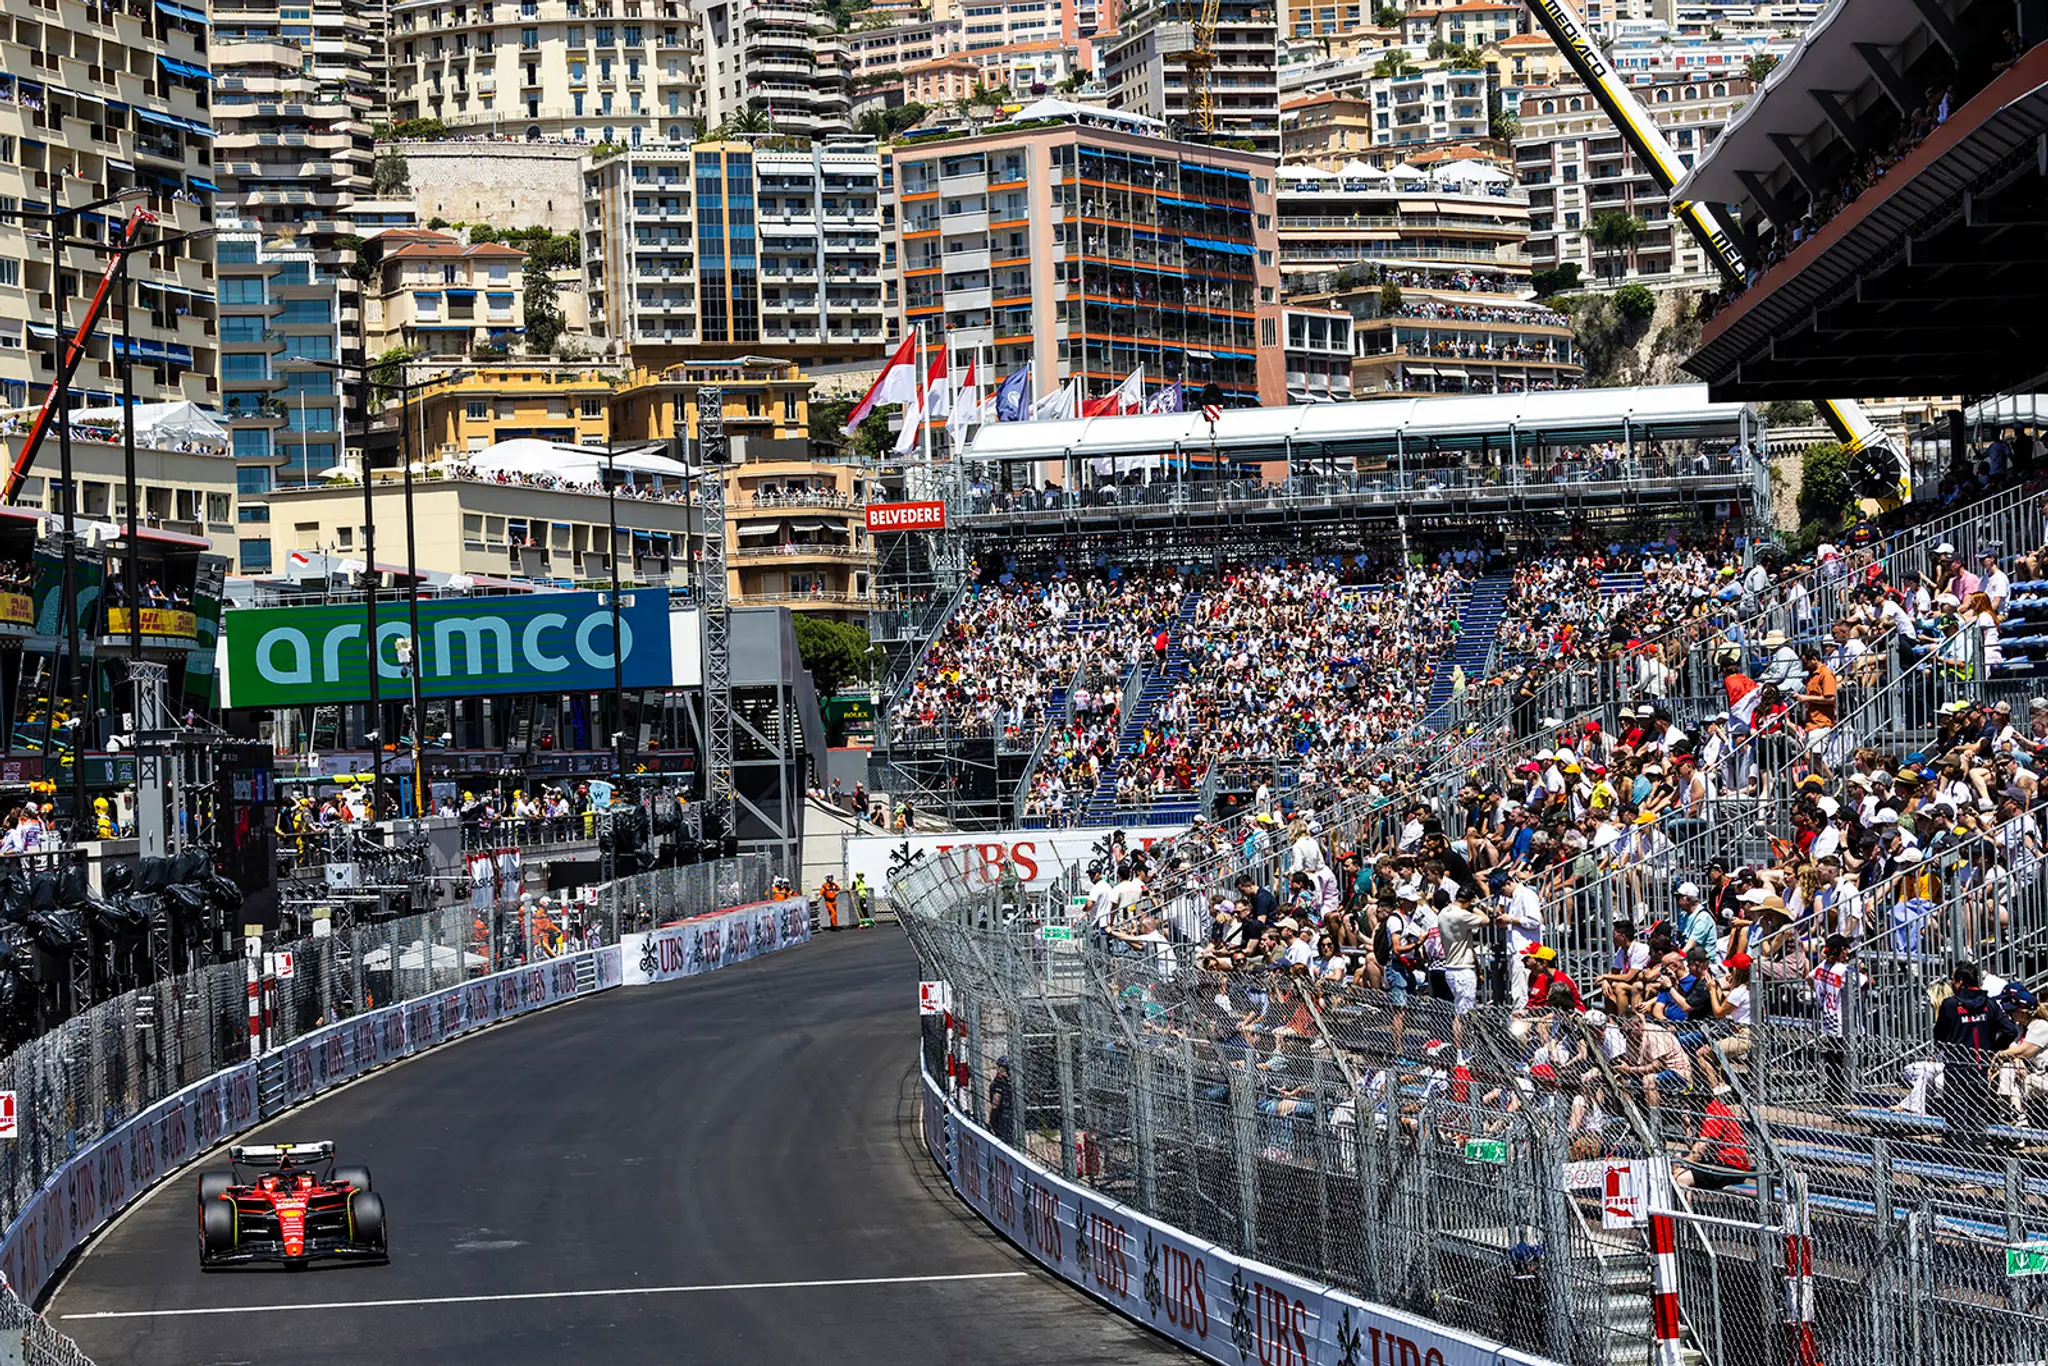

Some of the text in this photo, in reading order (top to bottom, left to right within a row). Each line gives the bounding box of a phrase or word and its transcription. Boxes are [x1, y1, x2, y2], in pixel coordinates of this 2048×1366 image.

[870, 507, 940, 525] BELVEDERE
[256, 610, 634, 685] aramco
[843, 711, 868, 719] ROLEX
[936, 842, 1039, 882] UBS
[659, 936, 683, 973] UBS
[704, 929, 720, 964] UBS
[294, 1045, 313, 1091] UBS
[327, 1033, 345, 1076] UBS
[360, 1021, 377, 1064] UBS
[389, 1012, 405, 1051] UBS
[417, 1003, 433, 1042] UBS
[445, 995, 460, 1031] UBS
[472, 984, 488, 1021] UBS
[501, 976, 518, 1011] UBS
[528, 969, 546, 1003] UBS
[559, 961, 576, 994] UBS
[76, 1159, 96, 1230] UBS
[106, 1141, 125, 1206] UBS
[136, 1121, 155, 1182] UBS
[168, 1103, 187, 1161] UBS
[201, 1087, 221, 1141] UBS
[233, 1071, 251, 1121] UBS
[1606, 1197, 1638, 1206] FIRE
[994, 1155, 1015, 1229] UBS
[1033, 1182, 1062, 1262] UBS
[1091, 1212, 1128, 1299] UBS
[1161, 1243, 1209, 1338] UBS
[1254, 1281, 1308, 1366] UBS
